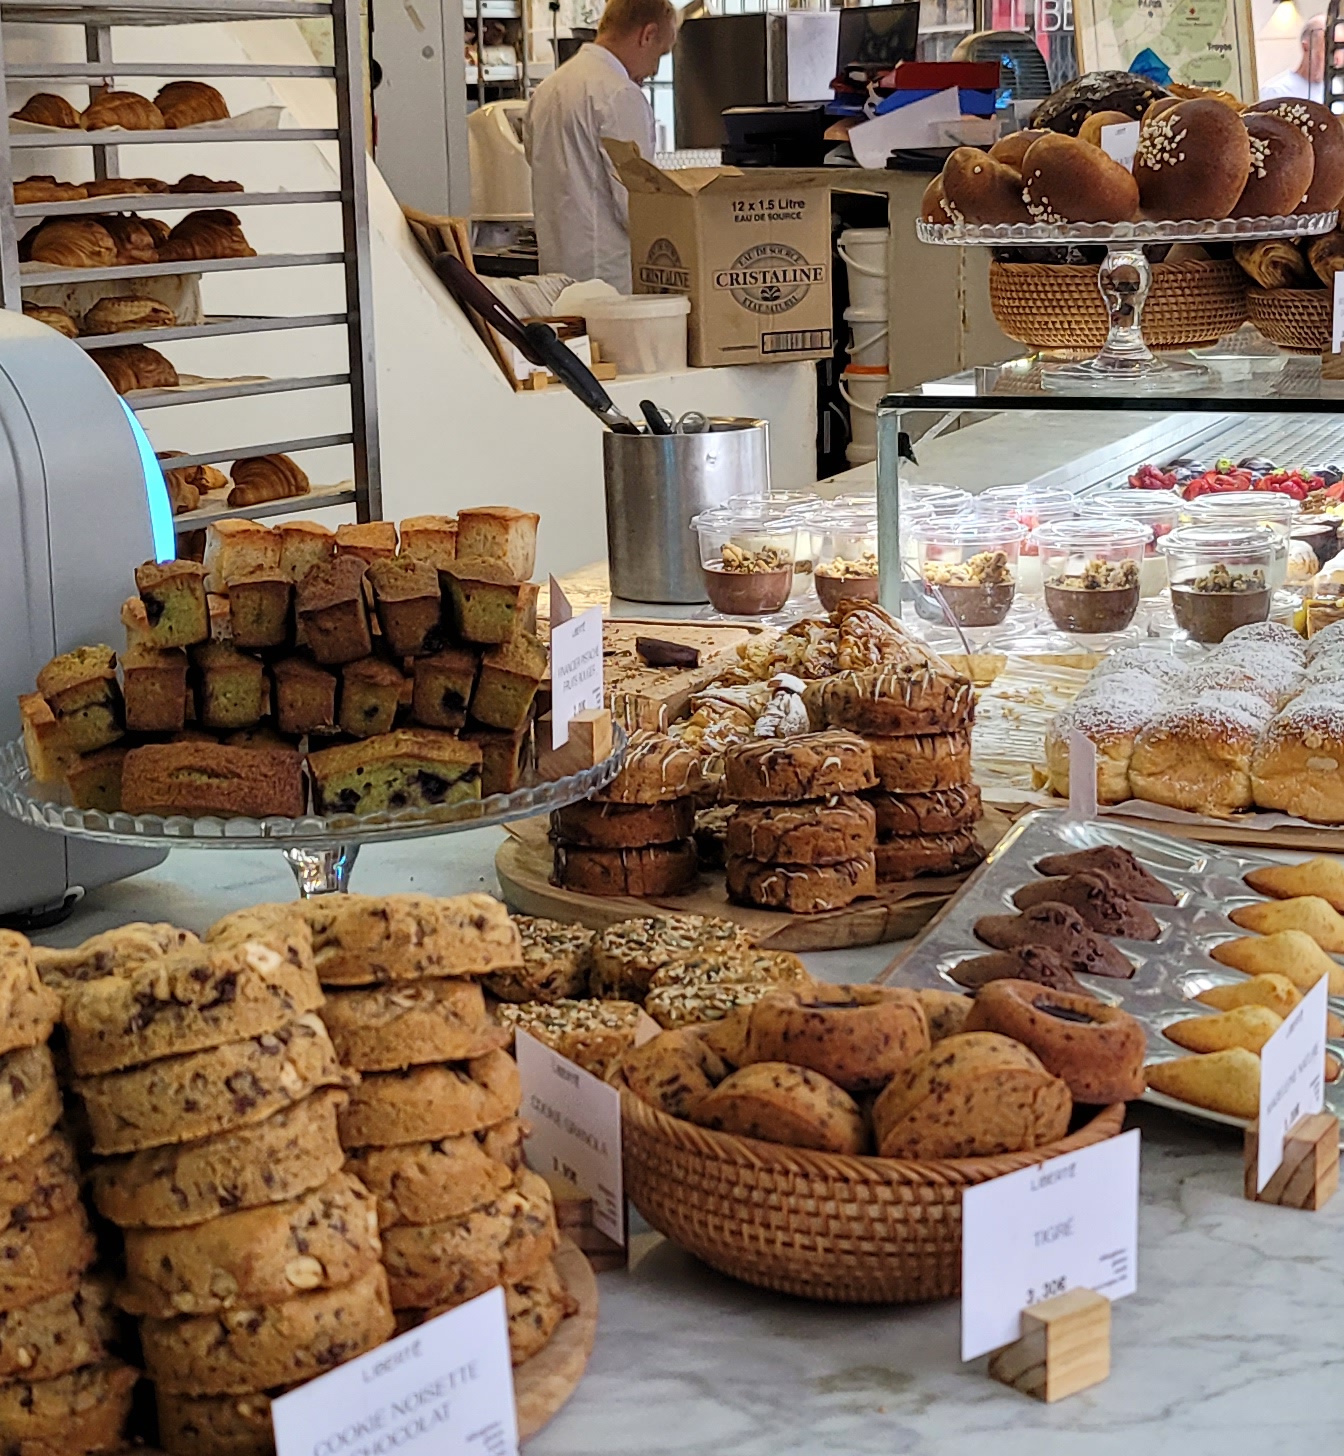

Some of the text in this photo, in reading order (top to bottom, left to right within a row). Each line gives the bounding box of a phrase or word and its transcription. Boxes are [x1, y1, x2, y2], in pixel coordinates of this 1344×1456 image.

[732, 198, 805, 212] 12 x 1.5 Litre
[754, 213, 765, 221] DE
[768, 211, 802, 221] SOURCE
[640, 268, 689, 288] CRISTALINE
[715, 267, 824, 287] CRISTALINE
[390, 1358, 481, 1420] NOISETTE
